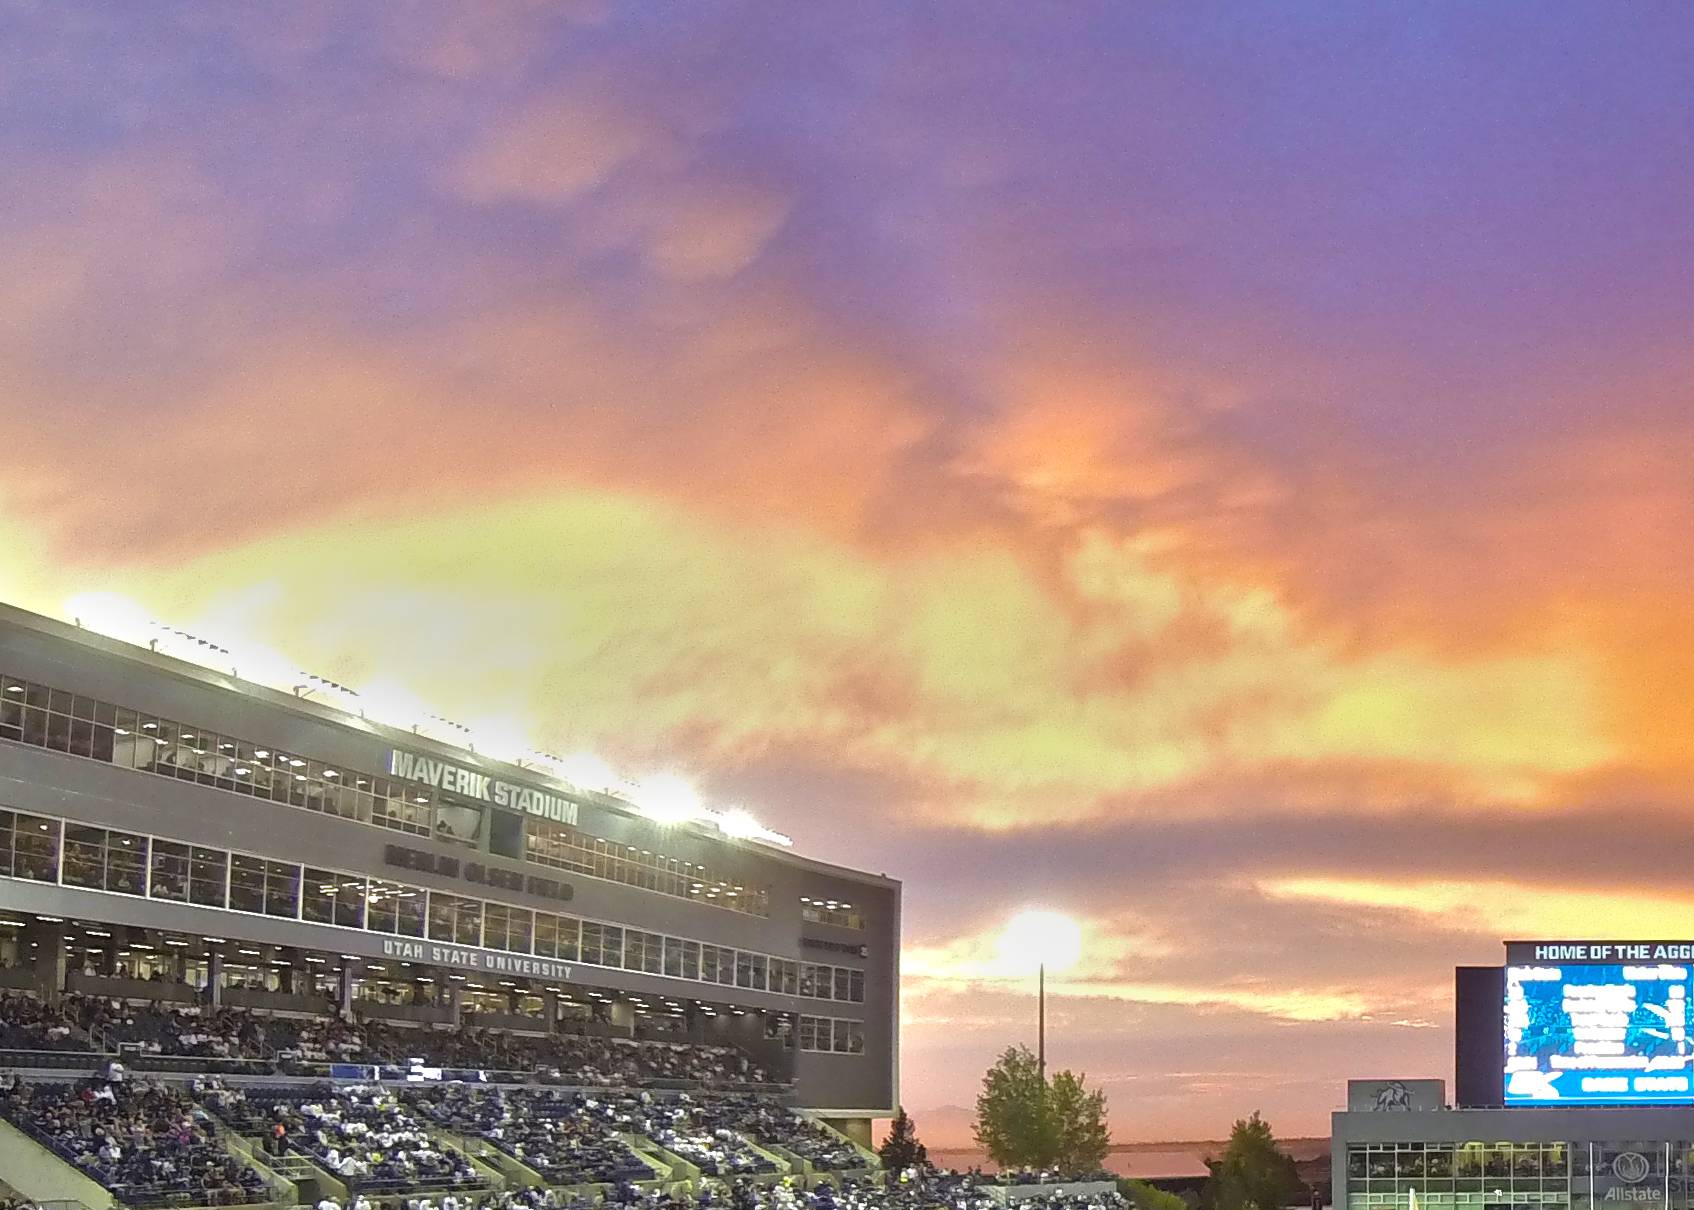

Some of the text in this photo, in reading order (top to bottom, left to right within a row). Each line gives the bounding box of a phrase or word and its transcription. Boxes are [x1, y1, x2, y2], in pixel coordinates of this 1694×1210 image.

[391, 749, 578, 826] MAVERIK STADIUM
[383, 940, 573, 979] UTAH STATE UNIVERSITY
[1535, 945, 1587, 960] HOME
[1590, 945, 1611, 960] OF
[1614, 945, 1650, 960] THE
[1604, 1187, 1661, 1201] Allstate
